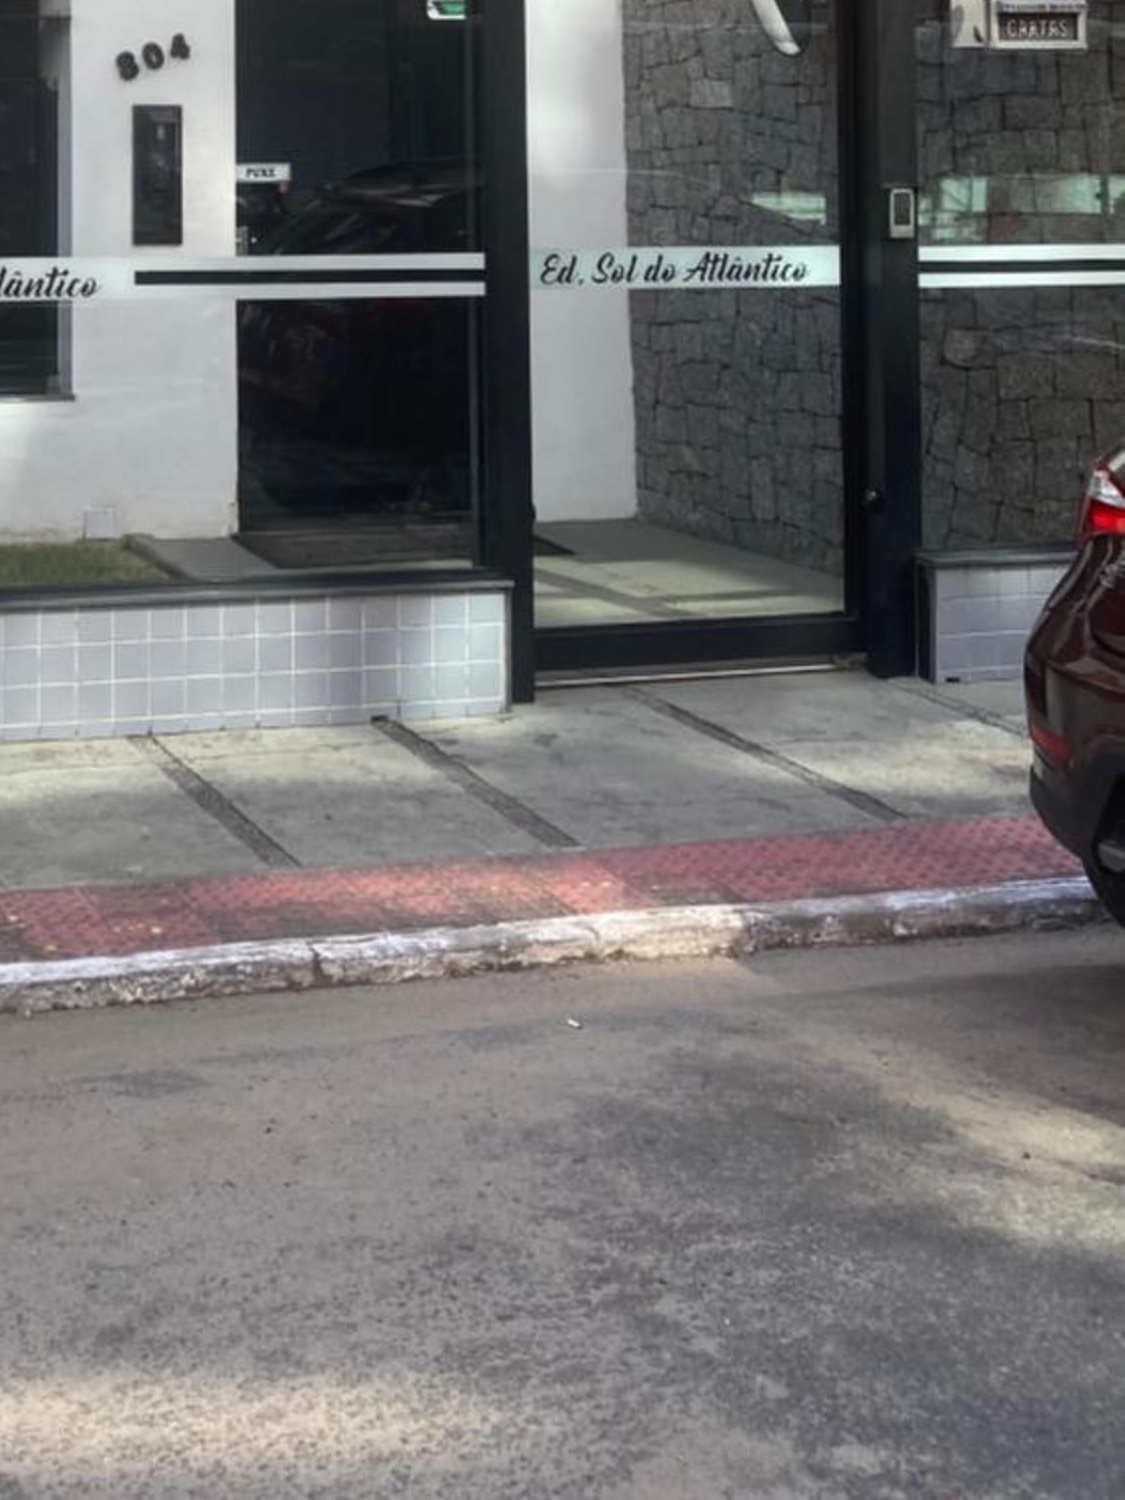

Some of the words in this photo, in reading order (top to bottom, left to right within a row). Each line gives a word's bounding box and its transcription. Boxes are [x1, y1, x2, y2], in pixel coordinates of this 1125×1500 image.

[115, 32, 191, 82] 804
[539, 252, 585, 286] Ed.
[590, 251, 638, 284] Sol
[642, 253, 676, 283] do
[681, 251, 810, 283] Atlântico
